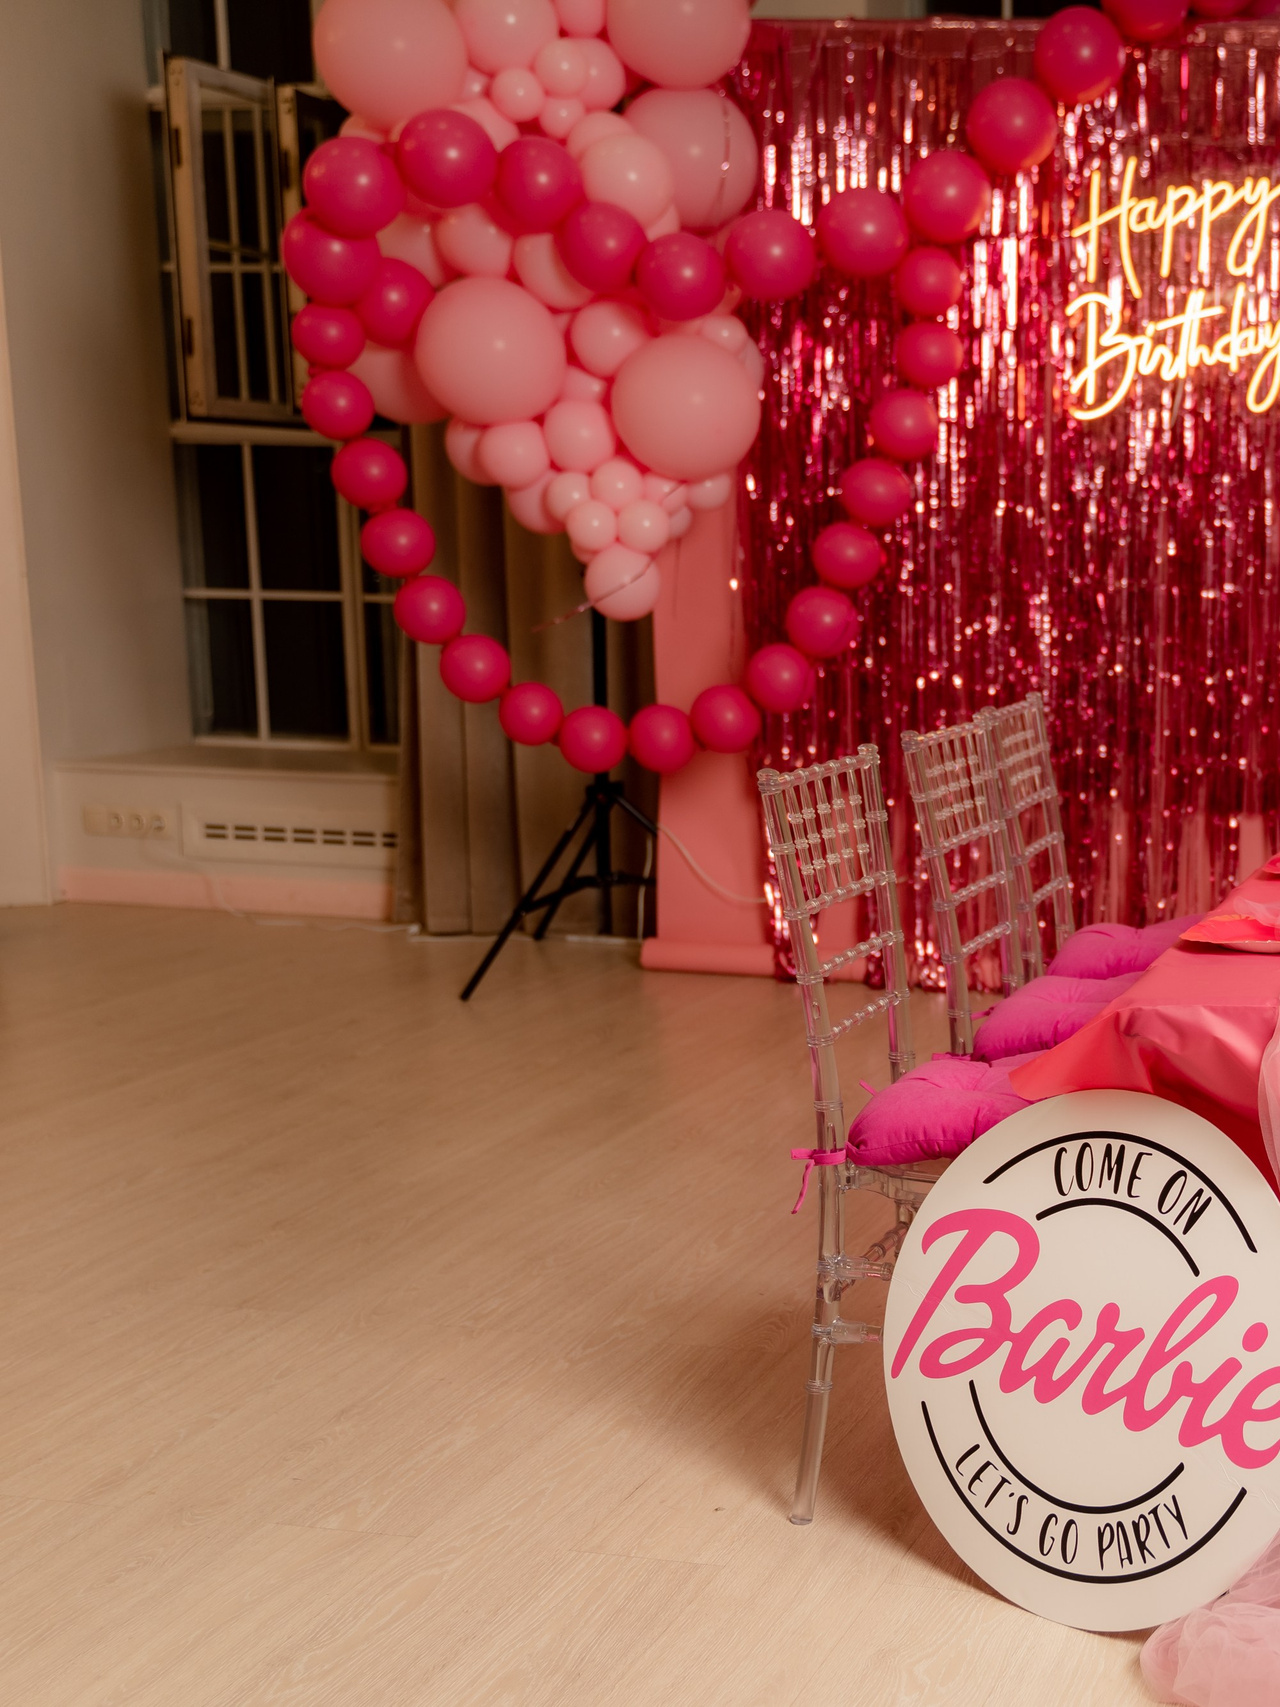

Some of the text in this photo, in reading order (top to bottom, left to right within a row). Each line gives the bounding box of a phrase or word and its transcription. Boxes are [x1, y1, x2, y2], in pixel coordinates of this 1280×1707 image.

[1053, 1141, 1213, 1236] COME ON
[955, 1443, 1189, 1571] LET'S GO PARTY
